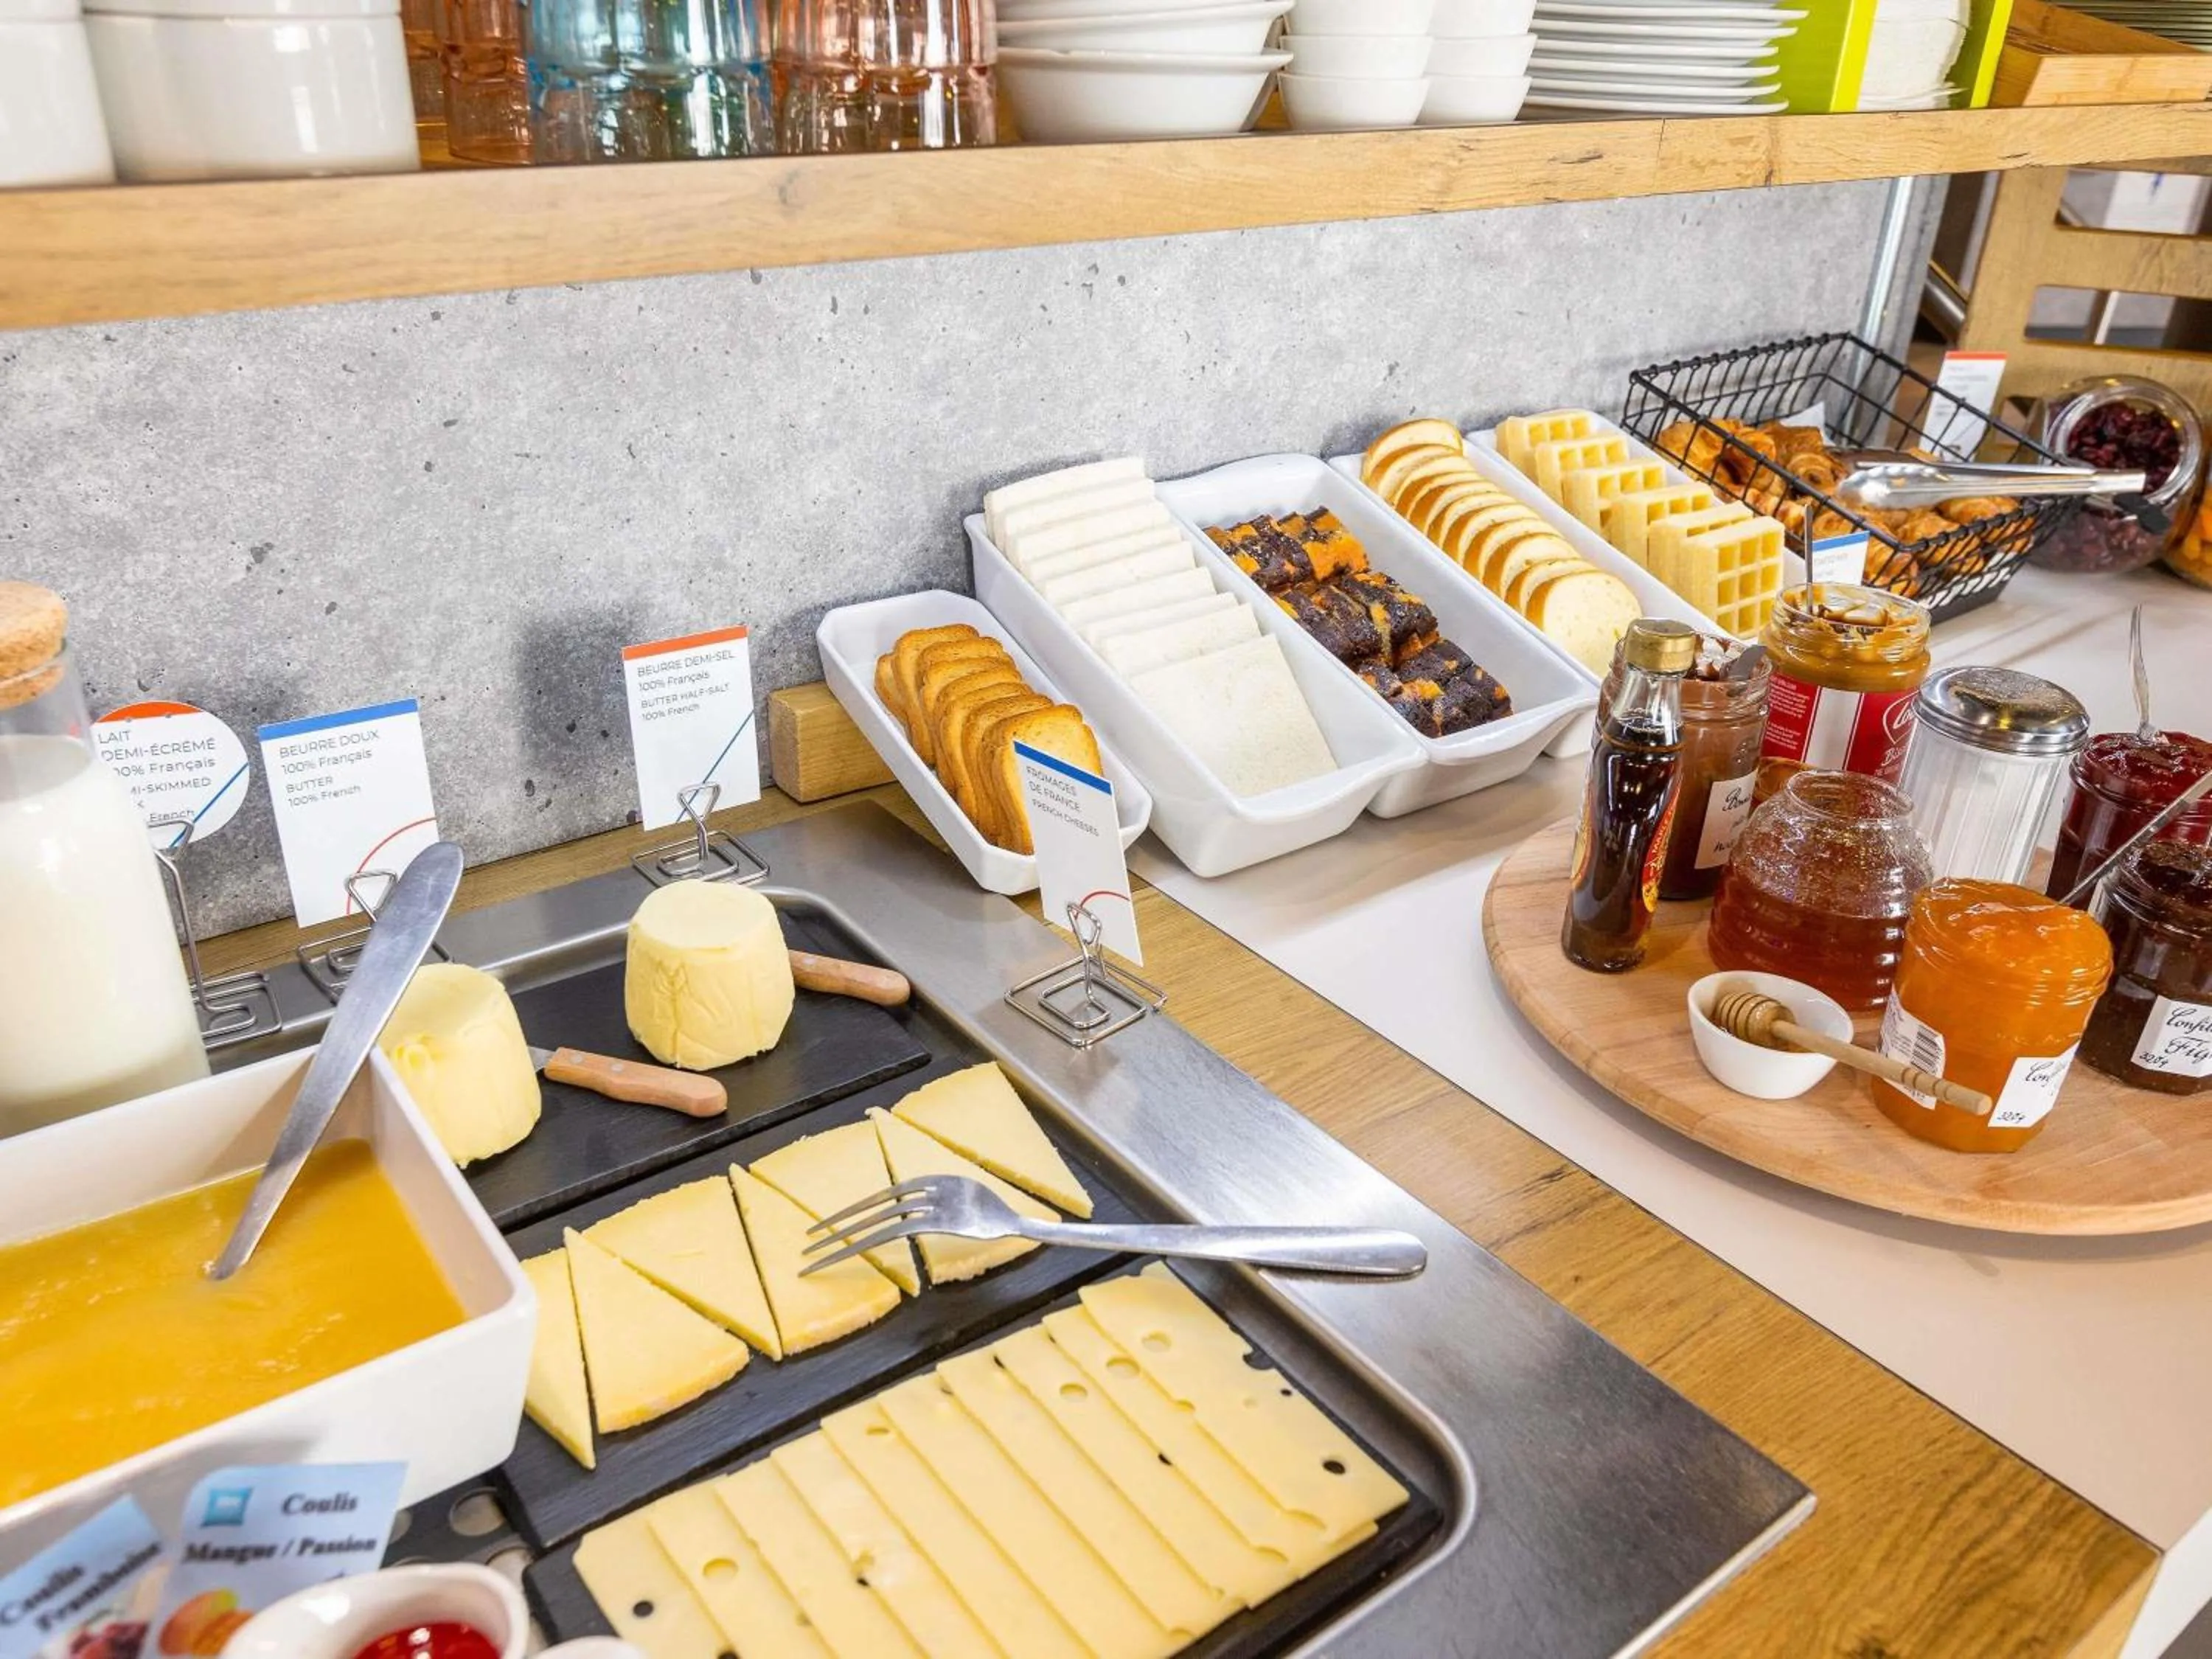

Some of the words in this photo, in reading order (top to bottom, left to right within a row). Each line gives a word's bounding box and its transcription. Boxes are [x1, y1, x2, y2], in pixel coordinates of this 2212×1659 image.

[637, 658, 683, 678] BEURRE
[684, 650, 736, 669] DEMI-SEL
[639, 679, 665, 692] 100%
[667, 670, 711, 686] Français
[641, 694, 678, 709] BUTTER
[681, 682, 730, 700] HALF-SALT
[642, 710, 665, 721] 100%
[667, 703, 700, 716] French
[97, 730, 131, 744] LAIT
[279, 737, 337, 759] BEURRE
[340, 729, 380, 747] DOUX
[150, 758, 216, 773] Français
[282, 760, 316, 775] 100%
[319, 748, 372, 768] Français
[286, 776, 333, 794] BUTTER
[1026, 765, 1077, 796] FROMAGES
[288, 794, 319, 807] 100%
[321, 785, 361, 801] French
[1028, 781, 1043, 796] DE
[1043, 787, 1082, 813] FRANCE
[1032, 799, 1062, 819] FRENCH
[2166, 1006, 2212, 1034] Confit
[280, 1490, 359, 1515] Coulis
[181, 1541, 279, 1565] Mangue
[297, 1534, 378, 1556] Passion
